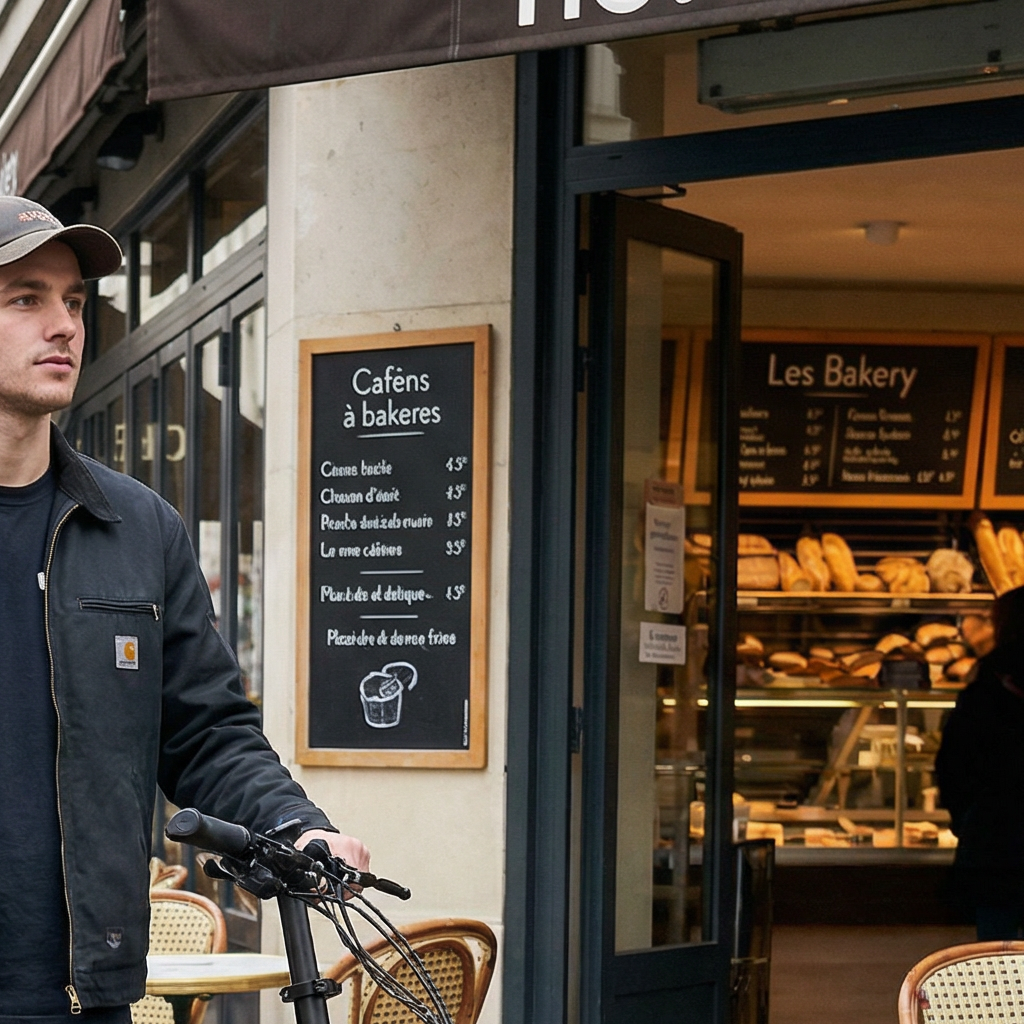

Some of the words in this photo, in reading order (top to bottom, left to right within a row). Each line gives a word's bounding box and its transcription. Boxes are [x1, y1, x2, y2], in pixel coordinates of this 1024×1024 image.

[768, 353, 814, 386] Les
[824, 353, 918, 399] Bakery
[343, 403, 355, 428] à
[362, 398, 441, 427] bakeres
